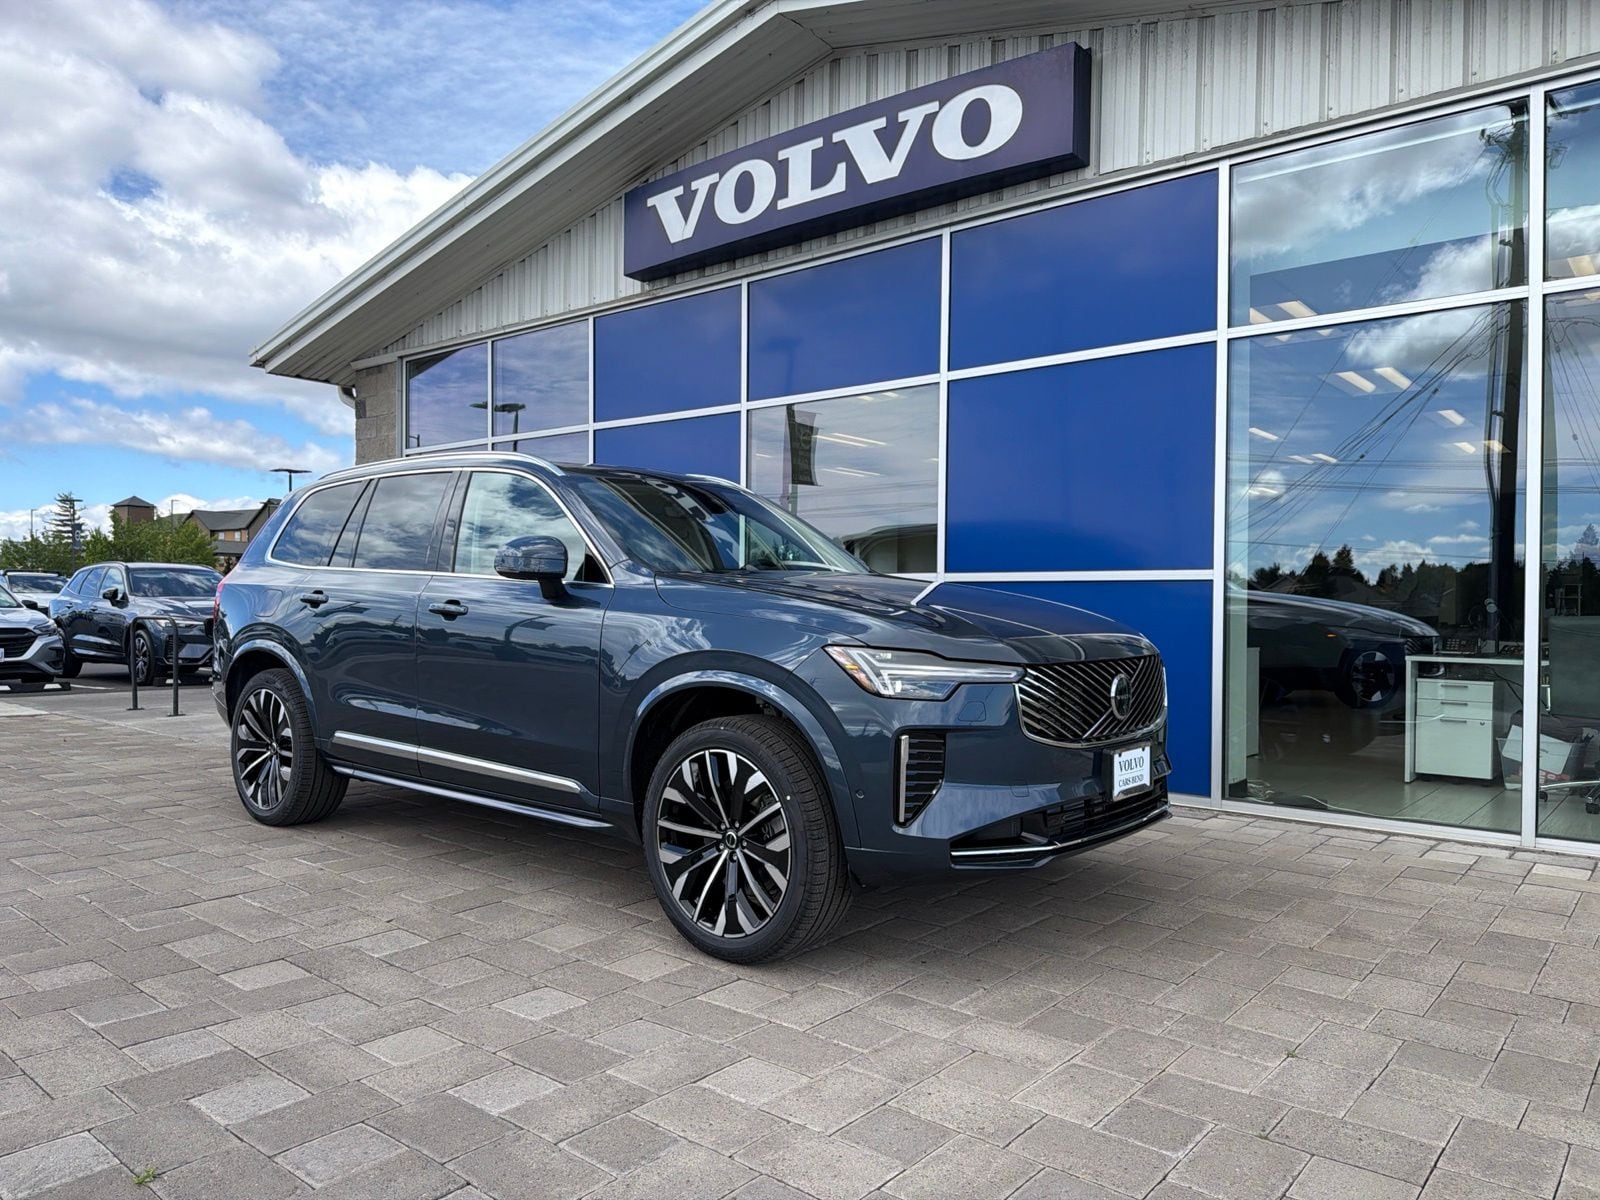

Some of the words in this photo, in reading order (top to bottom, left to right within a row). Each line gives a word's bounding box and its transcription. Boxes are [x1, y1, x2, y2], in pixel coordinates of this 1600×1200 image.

[647, 84, 1023, 244] VOLVO
[1118, 756, 1144, 773] VOLVO
[1118, 777, 1131, 788] CARS
